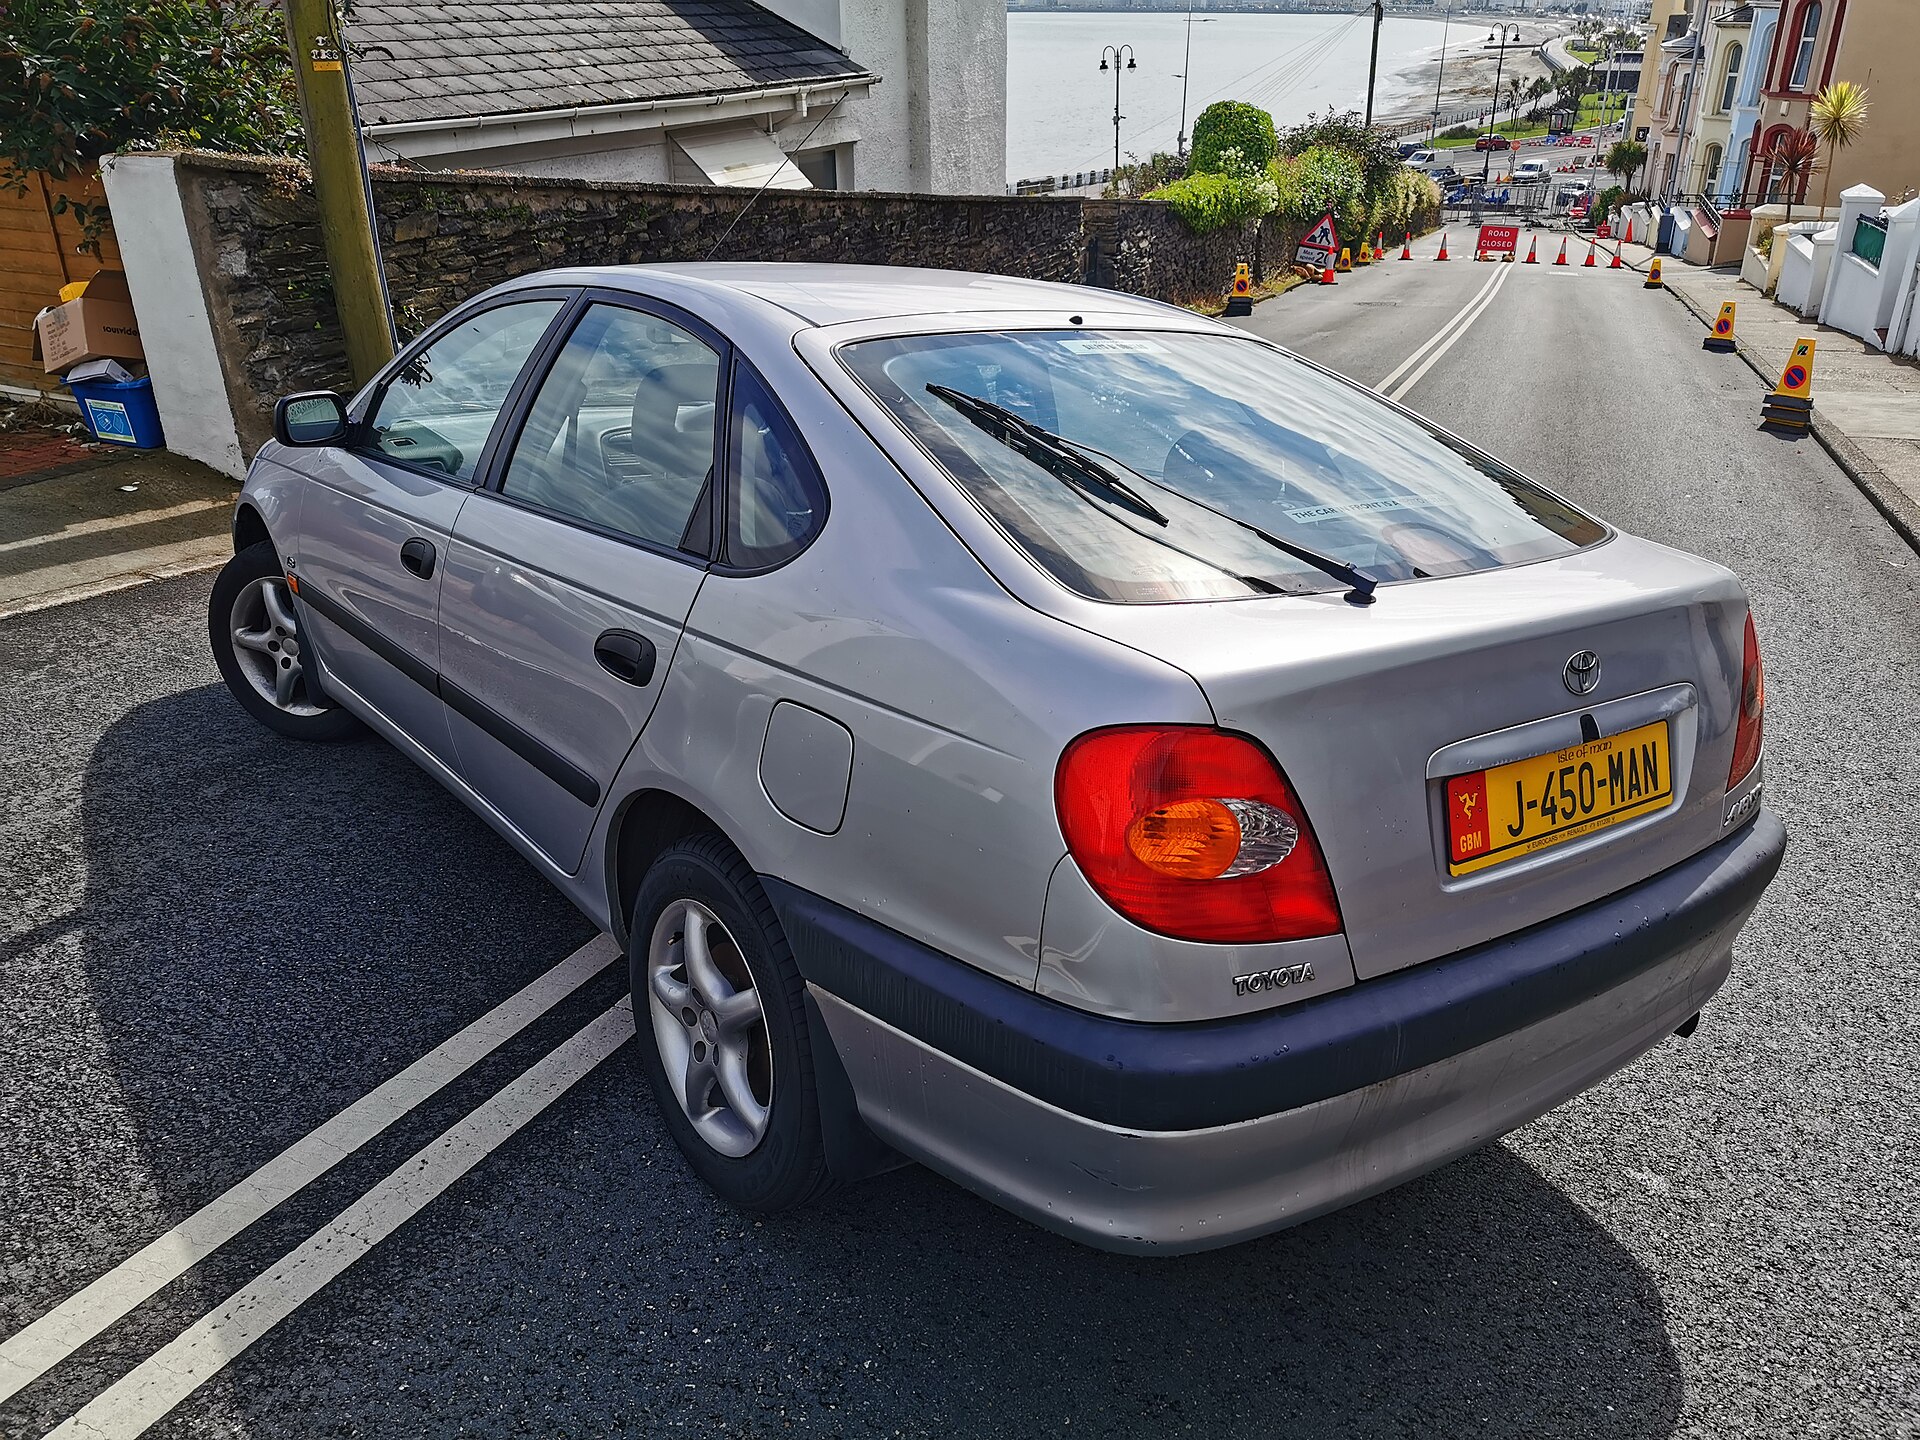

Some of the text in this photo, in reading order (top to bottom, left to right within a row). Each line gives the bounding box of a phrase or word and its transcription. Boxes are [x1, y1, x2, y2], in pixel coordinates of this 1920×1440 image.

[1488, 229, 1510, 237] ROAD
[1481, 240, 1513, 248] CLOSED
[1292, 510, 1316, 520] THE
[1315, 507, 1337, 517] CAR
[1350, 501, 1380, 512] FRONT
[1575, 745, 1588, 759] of
[1589, 740, 1612, 755] man
[1507, 740, 1660, 838] J-450-MAN
[1459, 830, 1482, 853] GBM
[1532, 833, 1558, 849] EUROCARS
[1567, 825, 1588, 838] RENAULT
[1233, 961, 1316, 996] TOYOTA
